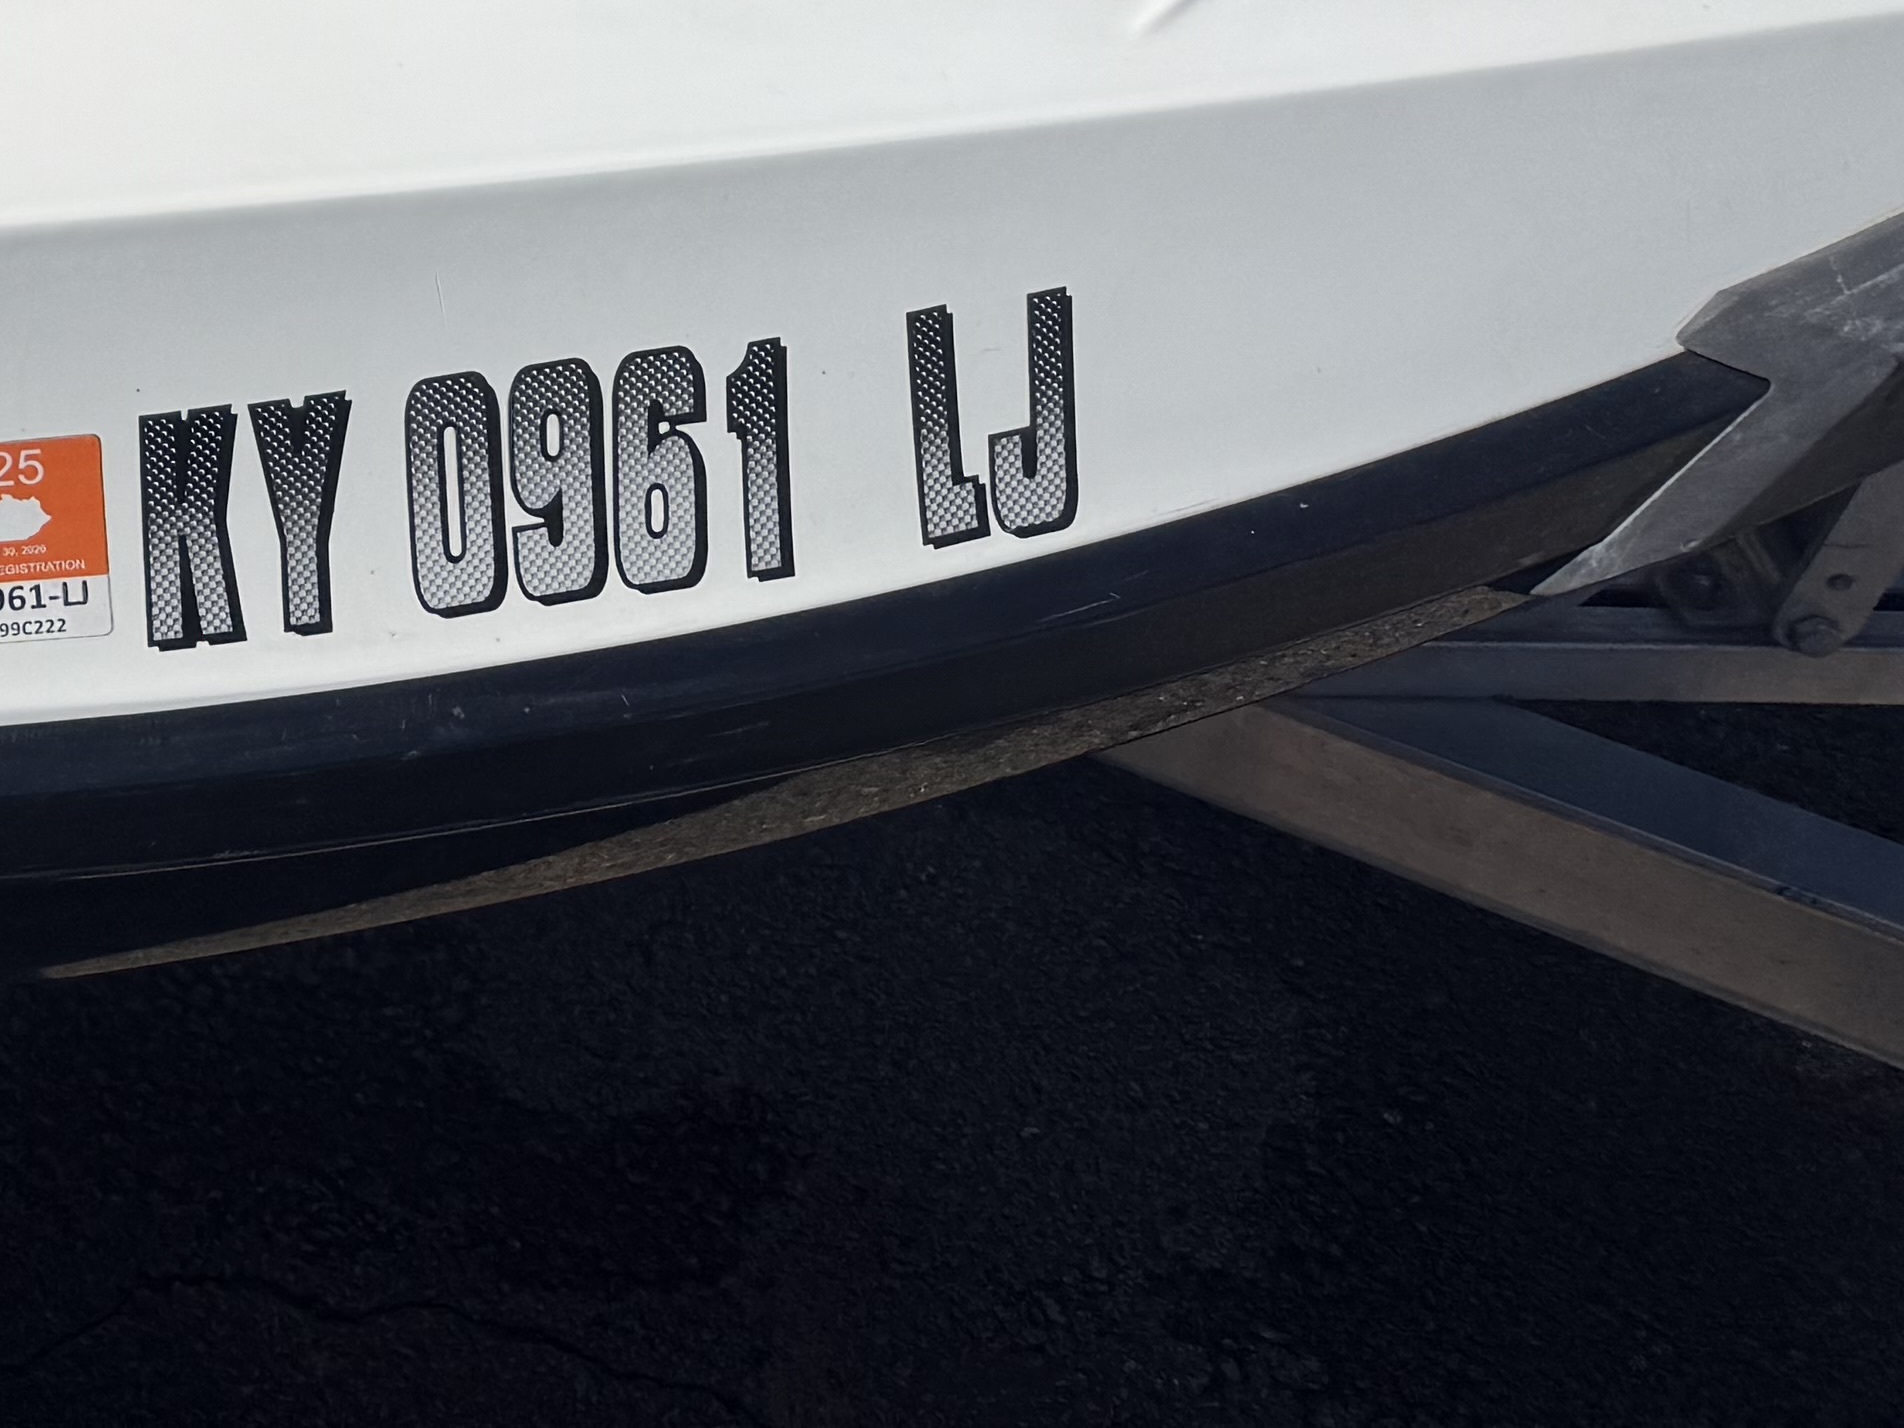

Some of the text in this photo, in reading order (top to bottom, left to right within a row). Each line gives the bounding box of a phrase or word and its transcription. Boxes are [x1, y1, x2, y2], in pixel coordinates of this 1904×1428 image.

[139, 286, 1078, 651] KY 0961 LJ
